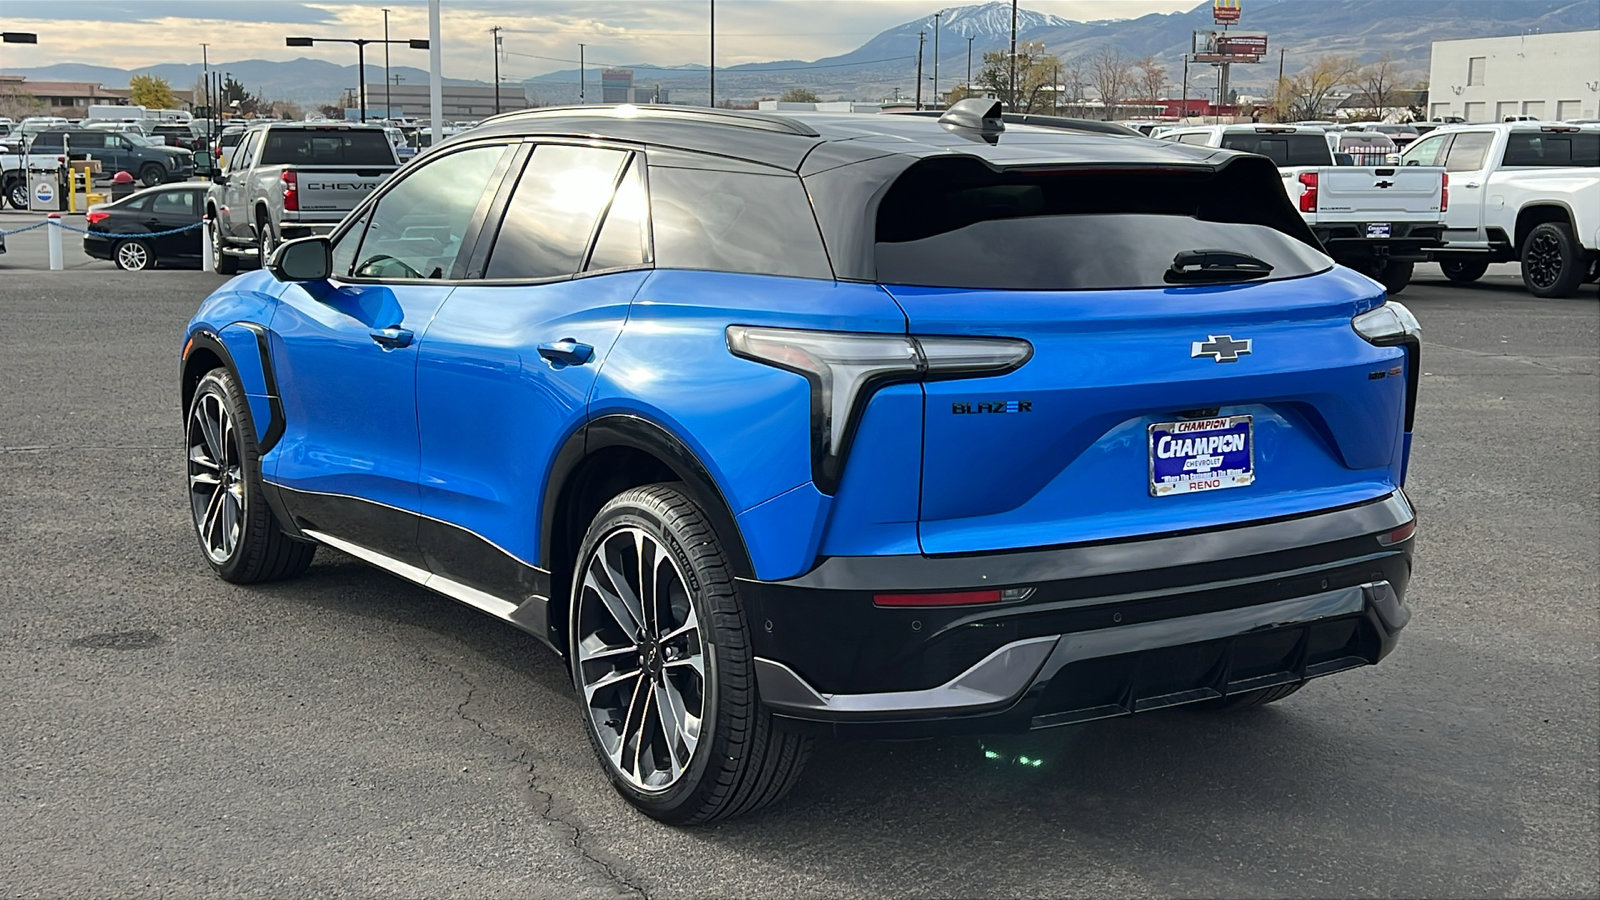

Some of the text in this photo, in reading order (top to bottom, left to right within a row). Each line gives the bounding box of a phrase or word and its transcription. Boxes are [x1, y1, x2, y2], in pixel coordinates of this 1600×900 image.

[952, 400, 1032, 414] BLAZER
[1178, 419, 1227, 432] CHAMPION
[1157, 433, 1245, 459] CHAMPION
[1186, 458, 1220, 468] CHEVROLET
[1189, 479, 1221, 490] RENO
[671, 541, 699, 589] MICHELIN
